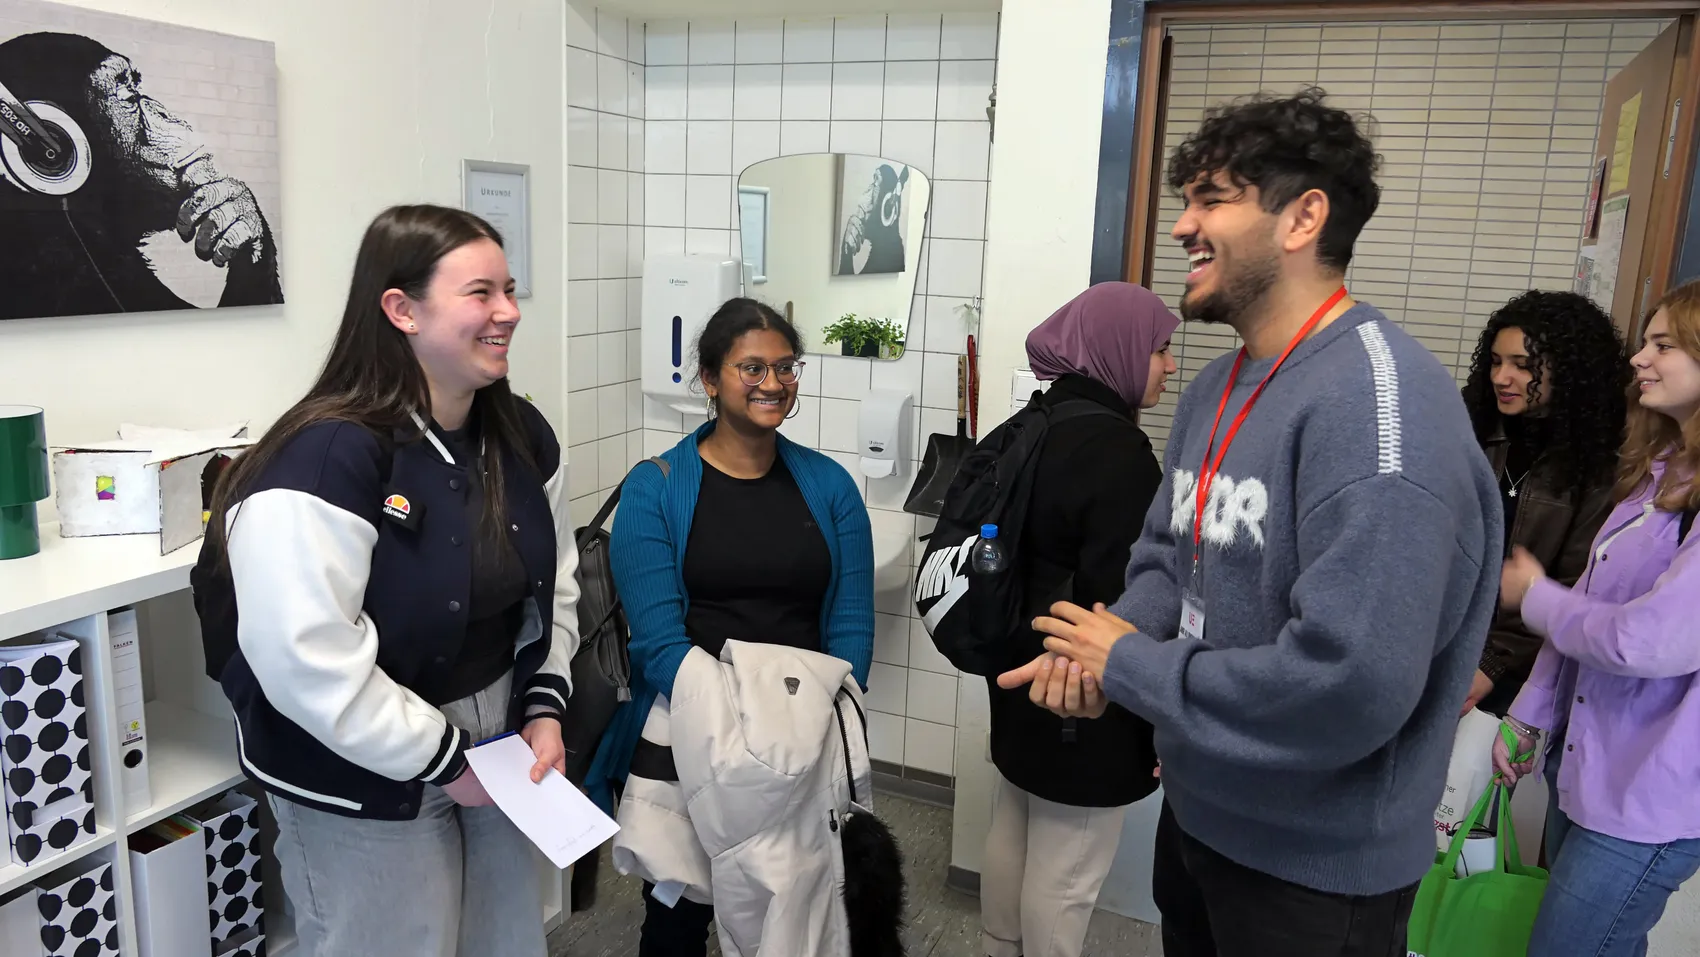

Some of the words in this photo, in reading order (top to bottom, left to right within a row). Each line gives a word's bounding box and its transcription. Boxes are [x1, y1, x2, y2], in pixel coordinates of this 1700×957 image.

[16, 121, 31, 136] HD
[480, 187, 511, 198] URKUNDE
[382, 506, 407, 520] ellesse
